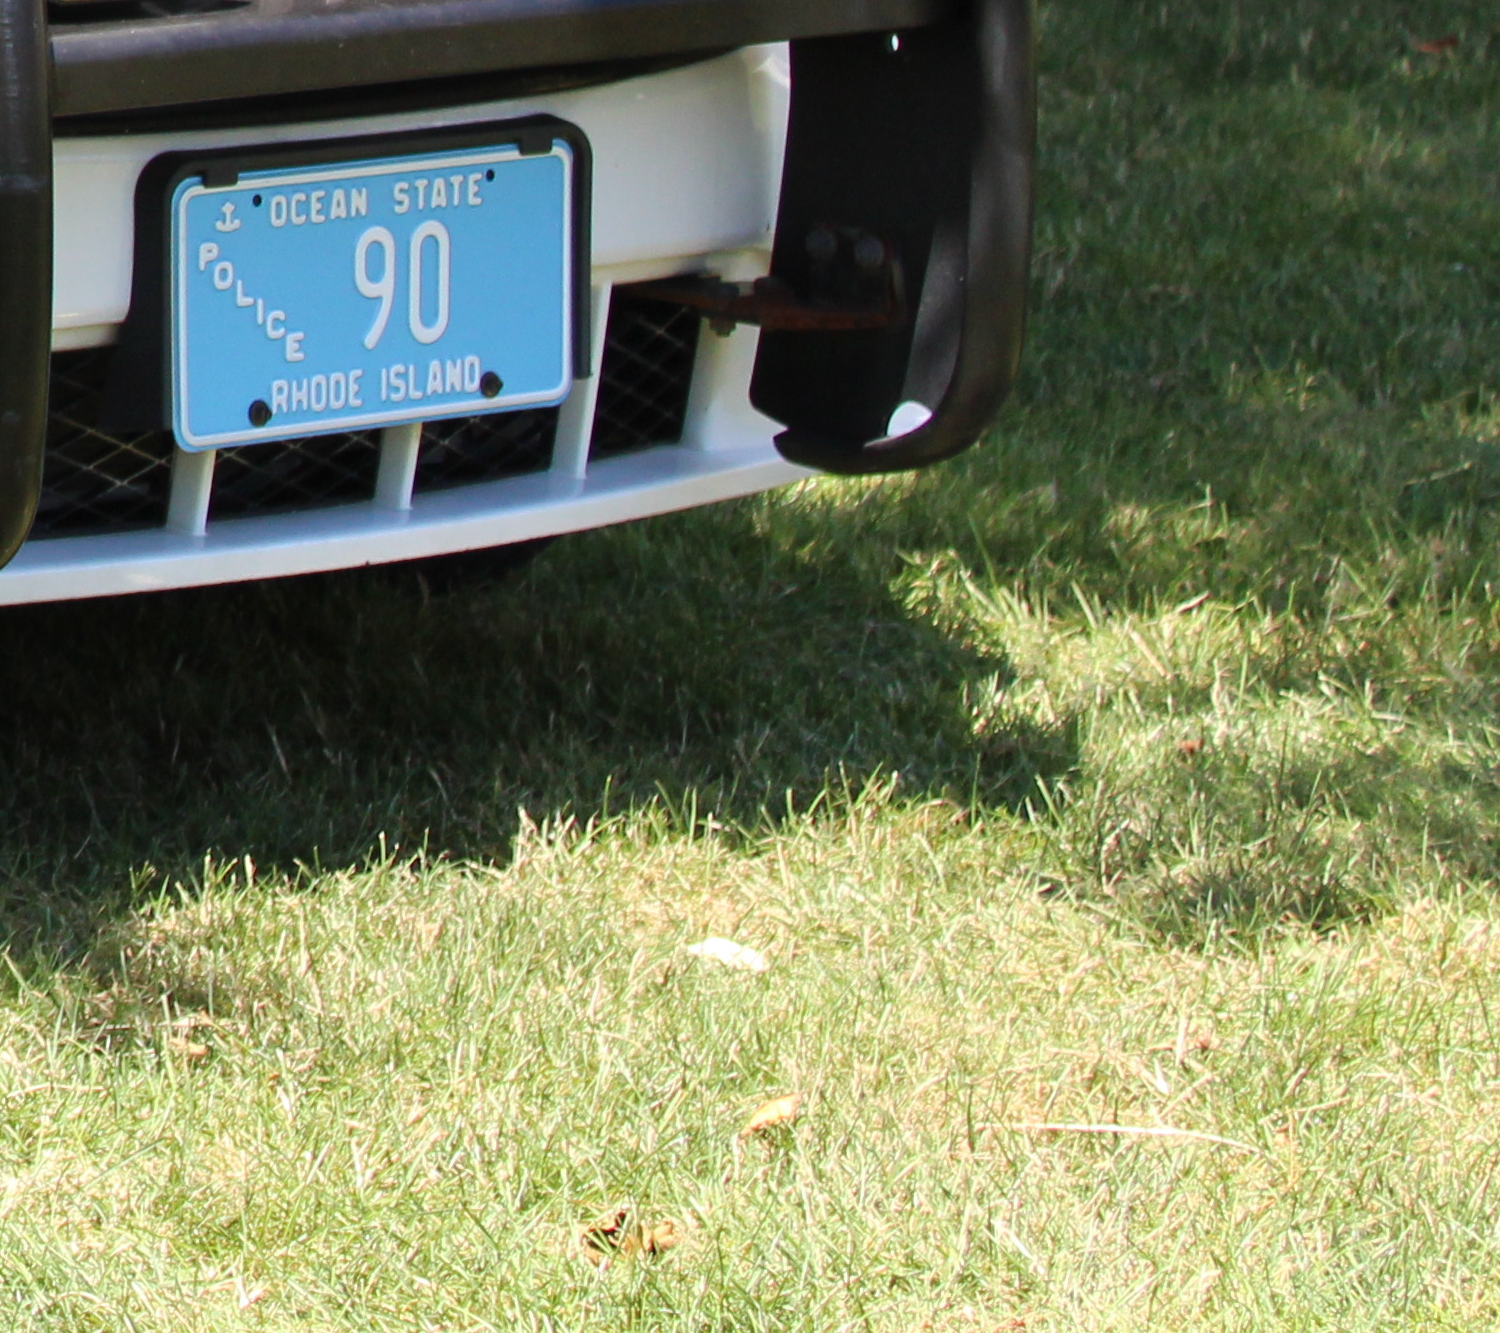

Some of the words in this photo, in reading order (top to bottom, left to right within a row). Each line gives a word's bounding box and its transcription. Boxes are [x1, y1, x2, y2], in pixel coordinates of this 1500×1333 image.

[271, 189, 368, 227] OCEAN
[393, 173, 484, 214] STATE
[199, 243, 305, 362] POLICE
[355, 220, 451, 350] 90
[271, 369, 364, 414] RHODE
[380, 356, 482, 402] ISLAND
